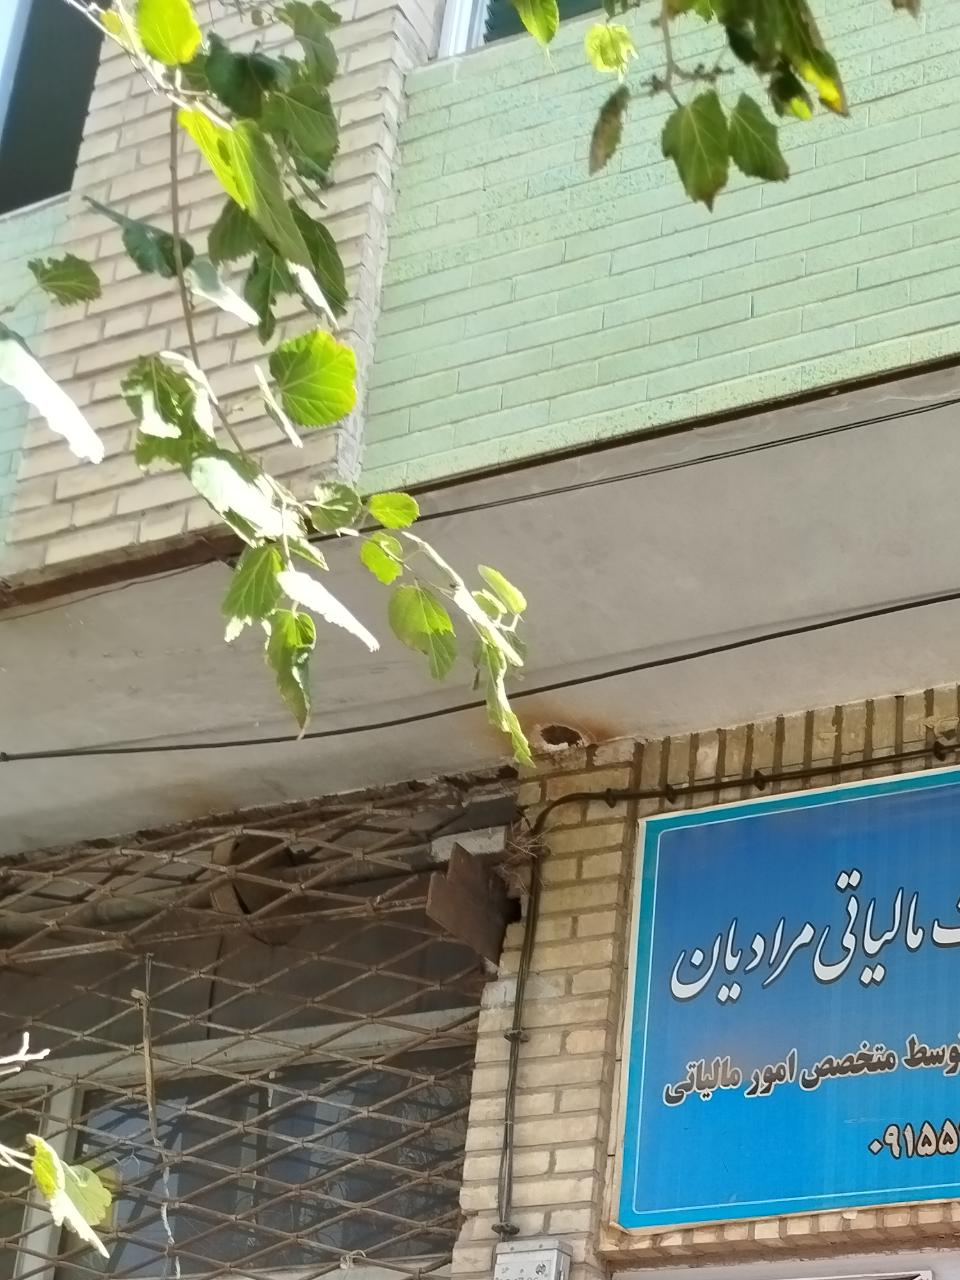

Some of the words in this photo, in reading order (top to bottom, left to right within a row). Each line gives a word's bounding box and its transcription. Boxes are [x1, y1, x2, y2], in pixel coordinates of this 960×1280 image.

[813, 868, 925, 986] مالیاتی
[670, 916, 815, 1004] مرادیان
[662, 1056, 742, 1107] مالیاتی
[744, 1048, 798, 1099] امور
[799, 1040, 898, 1091] متخصص
